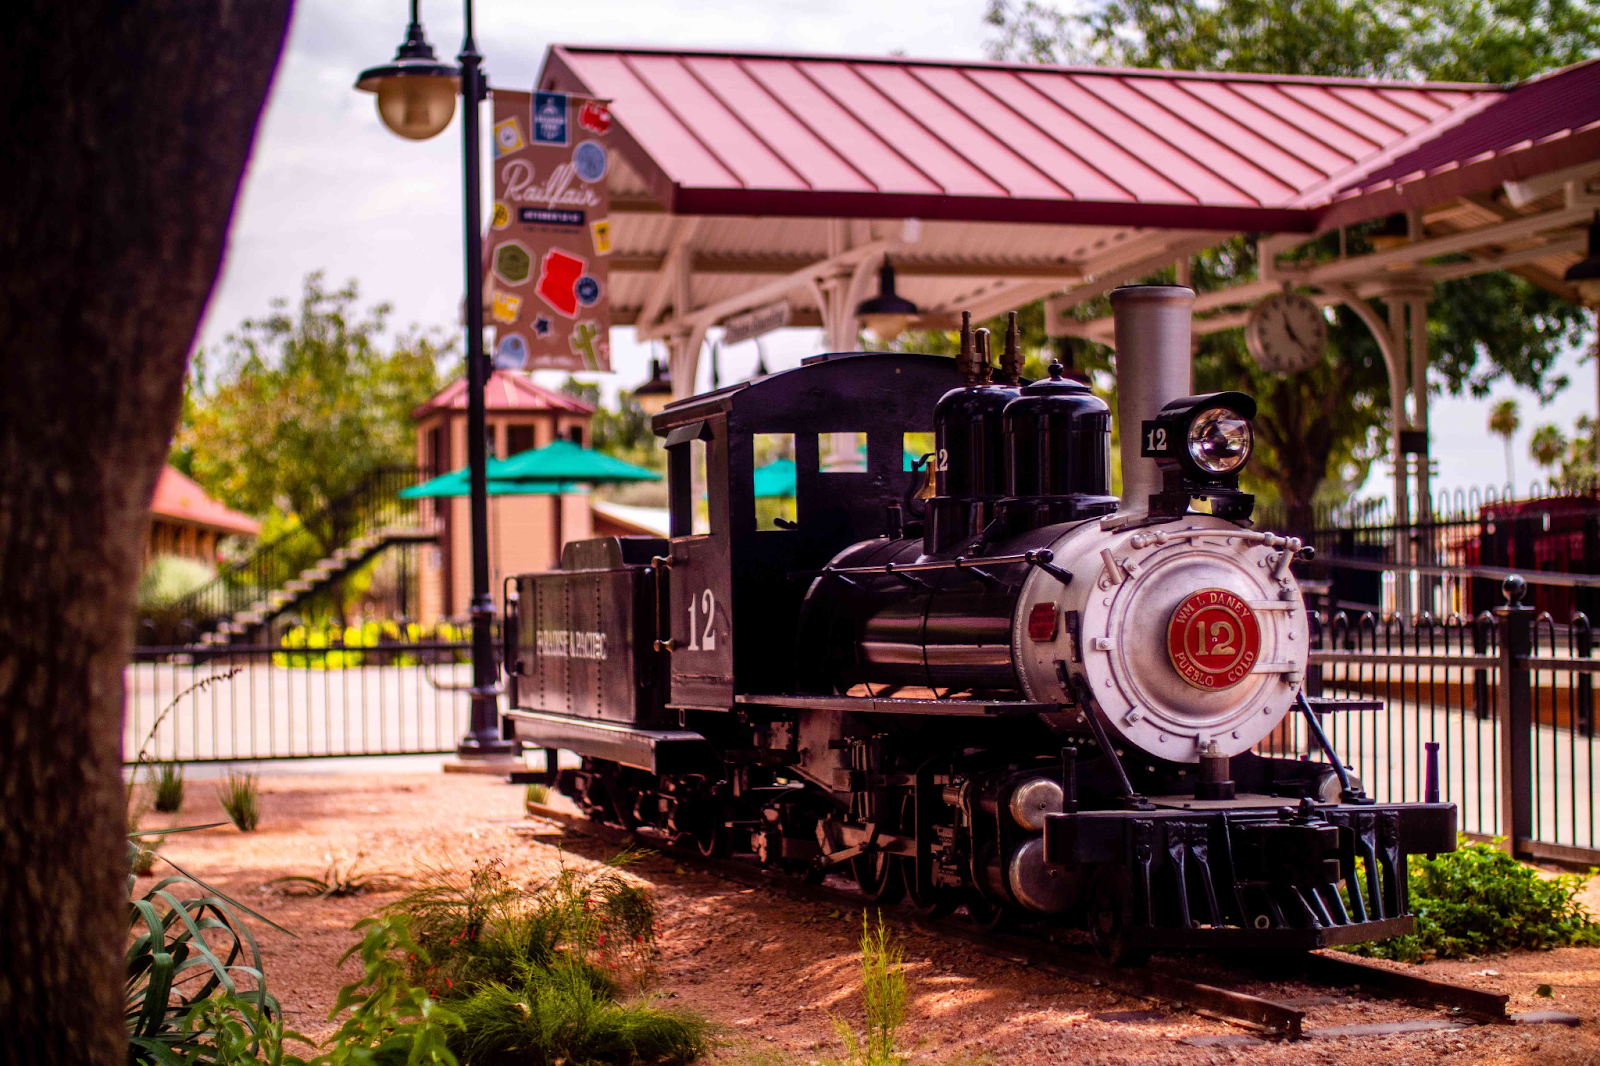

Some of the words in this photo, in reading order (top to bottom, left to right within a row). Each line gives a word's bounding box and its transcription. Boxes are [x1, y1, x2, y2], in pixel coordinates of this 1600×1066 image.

[1147, 428, 1167, 451] 12
[688, 588, 715, 651] 12
[1176, 603, 1195, 624] WM
[1196, 596, 1206, 607] L
[1210, 592, 1251, 618] DANEY
[1195, 621, 1236, 656] 12
[1175, 651, 1214, 687] PUEBLO
[1227, 651, 1254, 682] COLO
